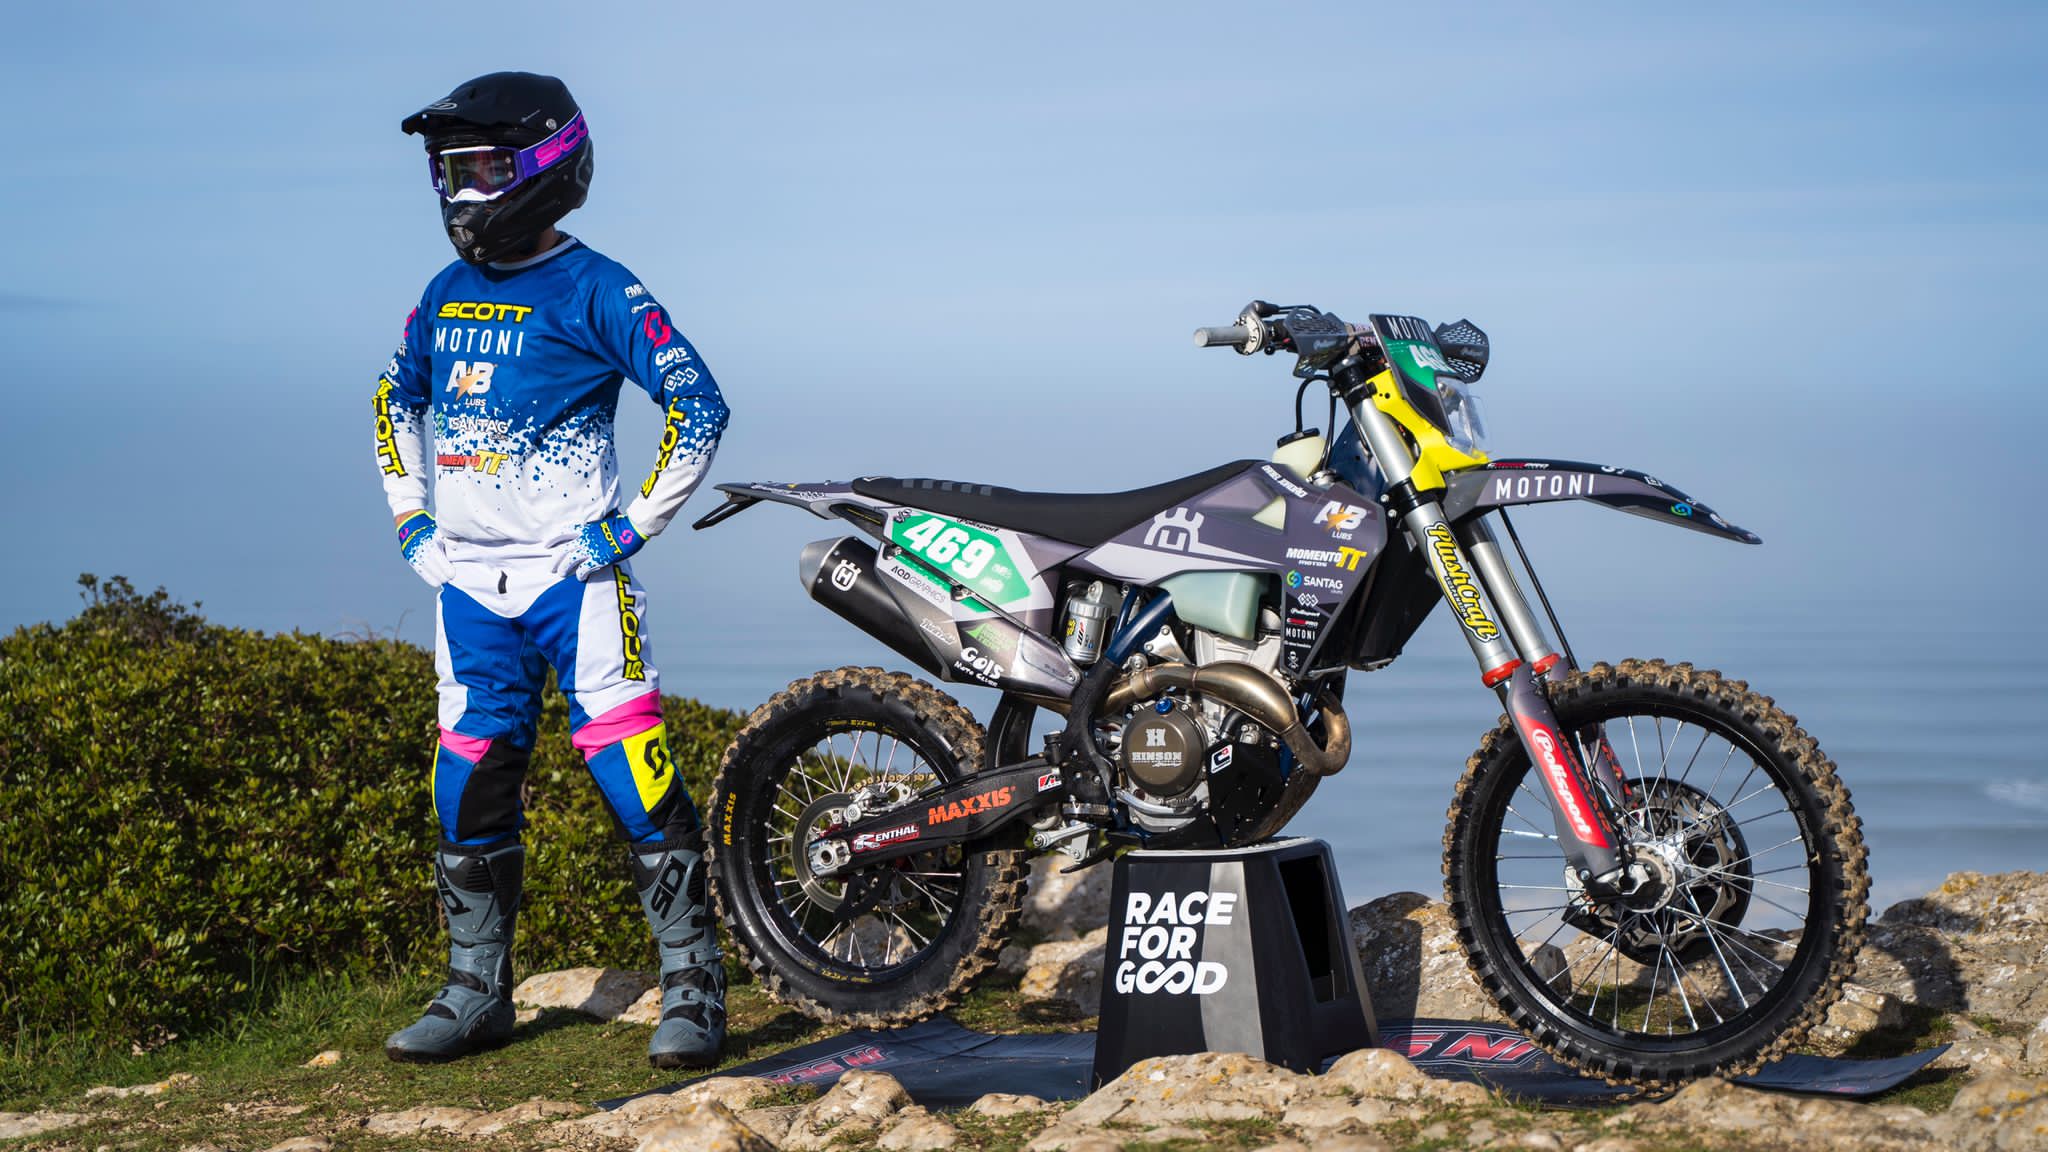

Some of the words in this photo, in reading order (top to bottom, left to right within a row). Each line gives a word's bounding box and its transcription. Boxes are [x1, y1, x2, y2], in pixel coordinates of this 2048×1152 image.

[438, 302, 533, 323] SCOTT
[434, 327, 525, 357] MOTONI
[465, 398, 487, 408] LUBS
[450, 417, 510, 435] SANTAG
[1495, 473, 1595, 500] MOTONI
[902, 517, 996, 579] 469
[1286, 547, 1342, 563] MOMENTO
[1335, 545, 1368, 572] TT
[1303, 576, 1344, 590] SANTAG
[1428, 524, 1499, 639] PlushCraft
[613, 564, 646, 681] SCOTT
[1285, 627, 1316, 641] MOTONI
[1532, 728, 1593, 835] Polisport
[723, 791, 737, 846] MAXXIS
[927, 785, 1012, 826] MAXXIS
[1124, 891, 1238, 926] RACE
[1119, 926, 1198, 960] FOR
[1114, 960, 1229, 995] GOOD
